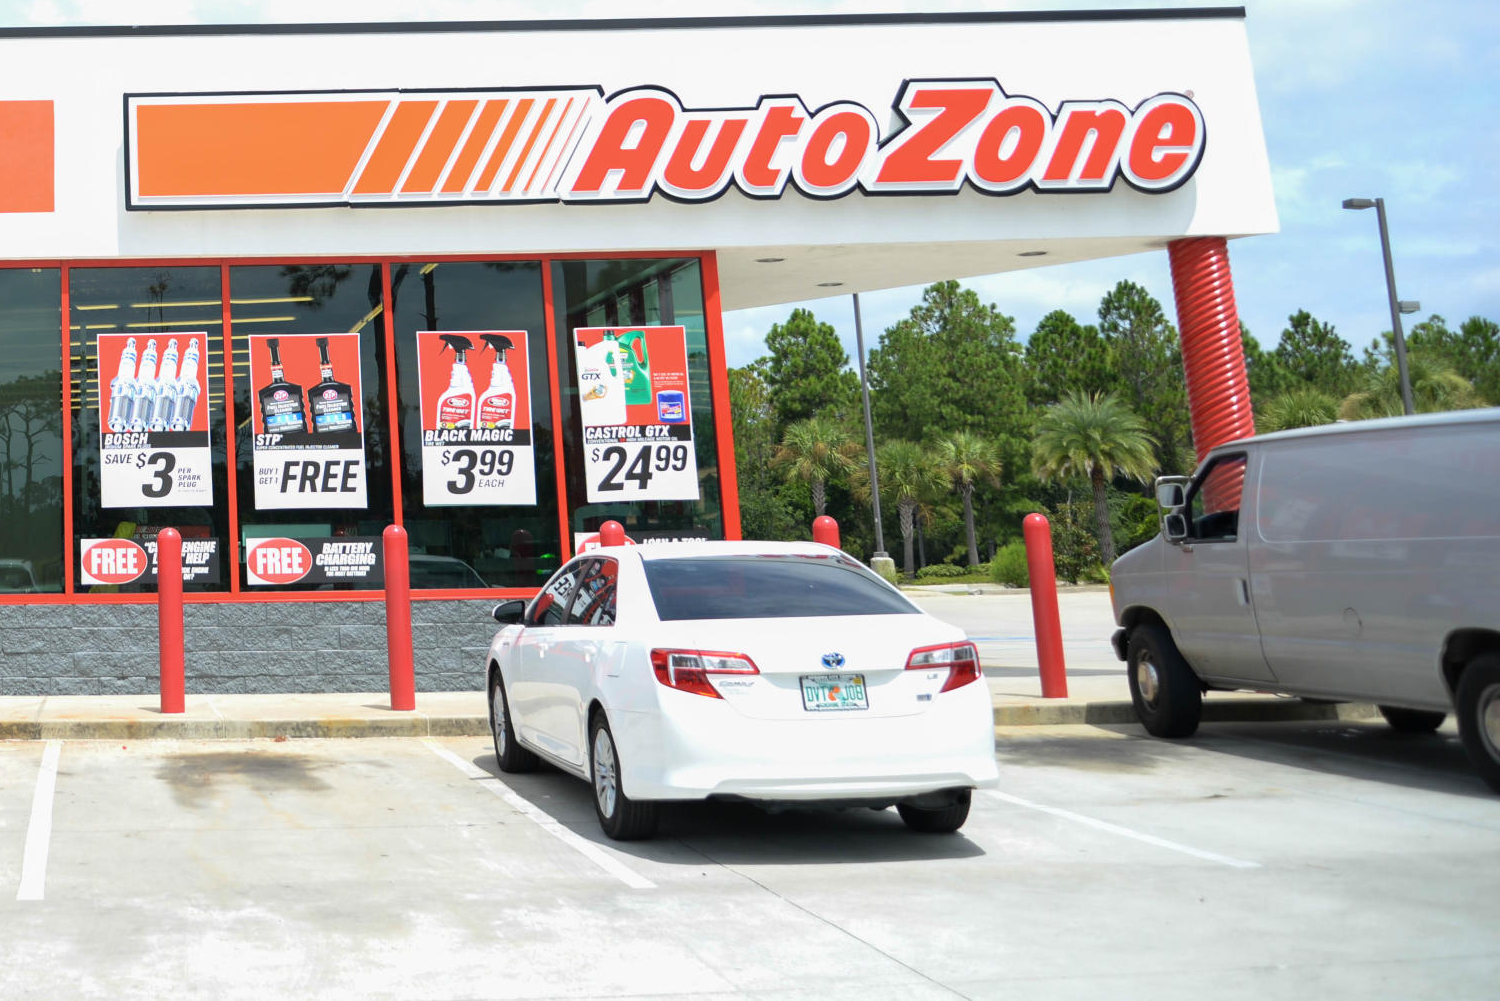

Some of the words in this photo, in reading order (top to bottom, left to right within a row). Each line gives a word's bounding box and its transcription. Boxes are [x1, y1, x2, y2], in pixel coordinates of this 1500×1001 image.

[571, 88, 1197, 192] AutoZone
[425, 429, 466, 441] BLACK
[470, 429, 514, 441] MAGIC
[586, 426, 641, 438] CASTROL
[645, 425, 670, 436] GTX
[105, 433, 149, 445] BOSCH
[105, 454, 132, 464] SAVE
[280, 460, 360, 493] FREE
[479, 479, 505, 487] EACH
[182, 541, 217, 553] ENGINE
[322, 542, 373, 554] BATTERY
[91, 548, 138, 574] FREE
[185, 552, 210, 564] HELP
[256, 547, 304, 575] FREE
[316, 553, 376, 565] CHARGING
